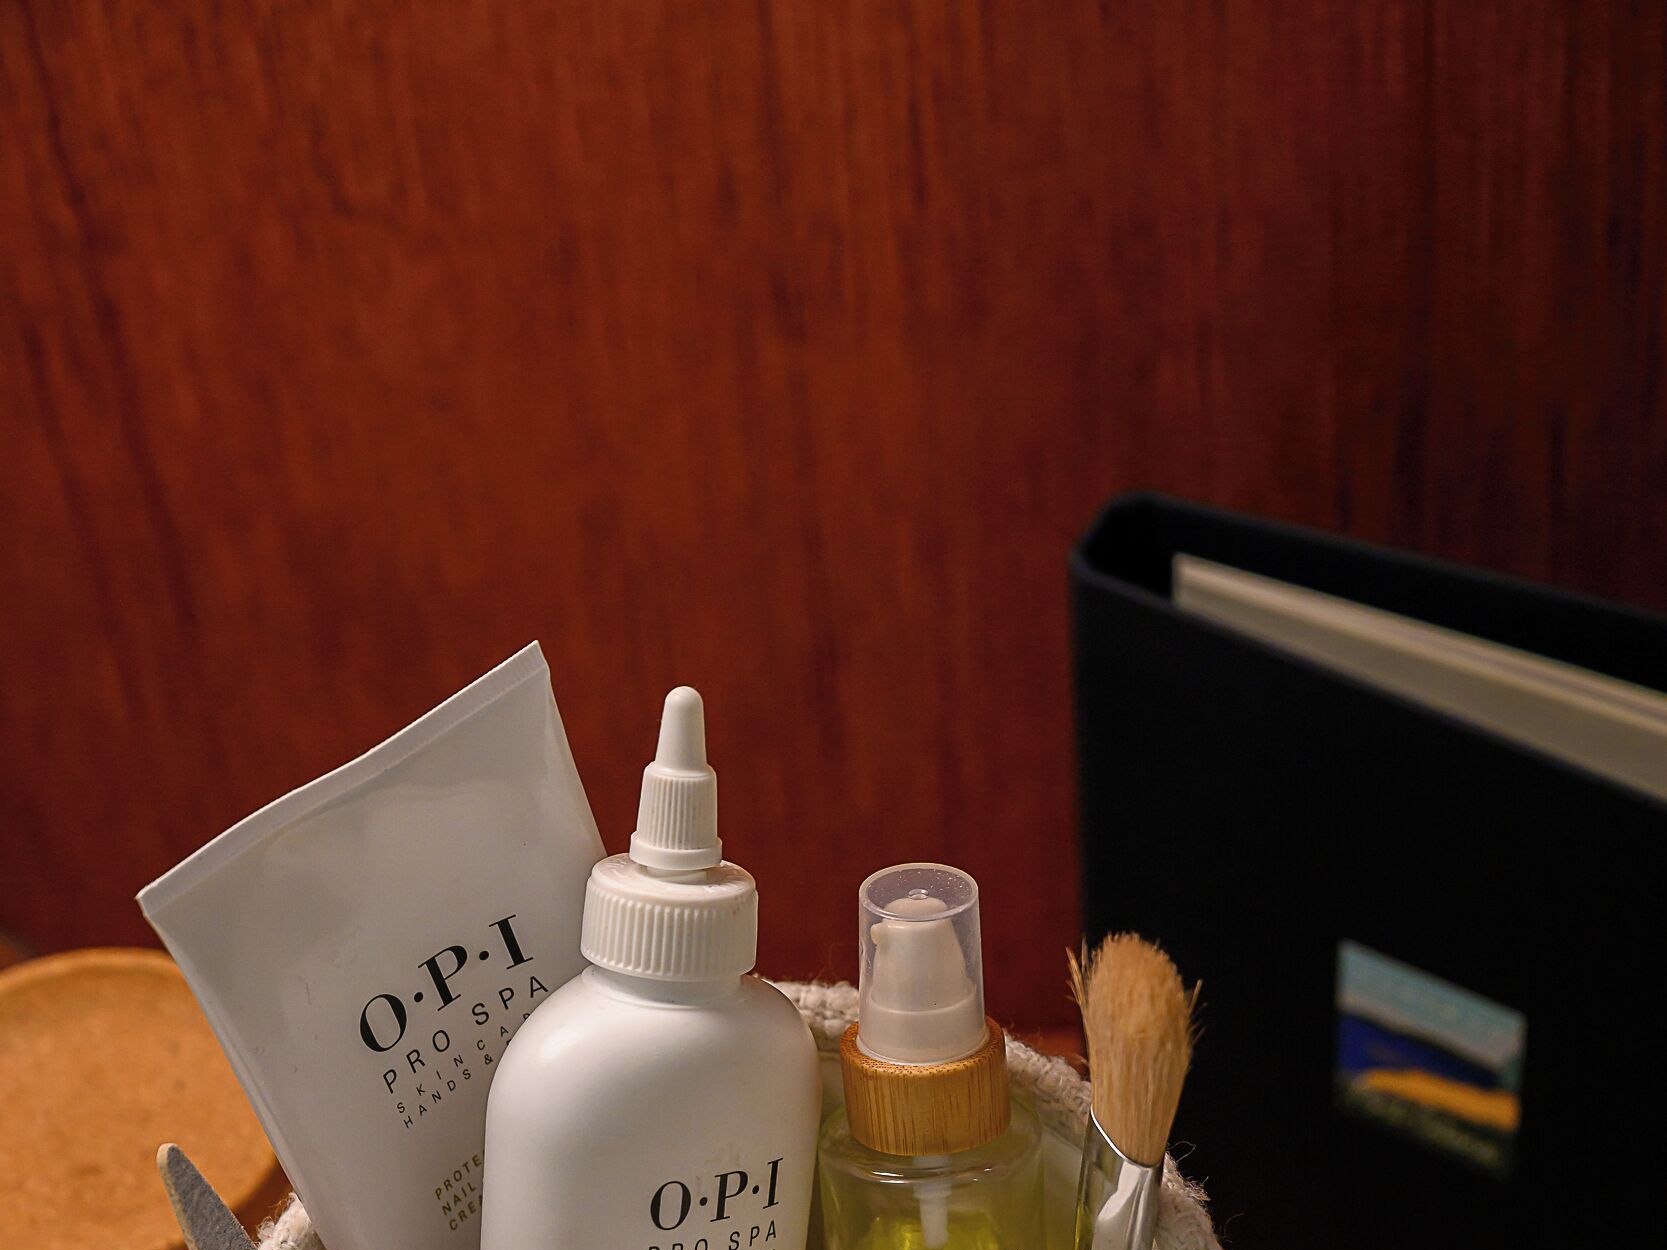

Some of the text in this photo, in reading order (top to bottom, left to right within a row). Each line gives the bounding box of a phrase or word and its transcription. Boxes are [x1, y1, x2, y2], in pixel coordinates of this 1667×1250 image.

[382, 975, 549, 1094] PRO SPA
[403, 1053, 494, 1129] HANDS &
[435, 1153, 484, 1201] PROTE
[442, 1182, 476, 1216] NAIL
